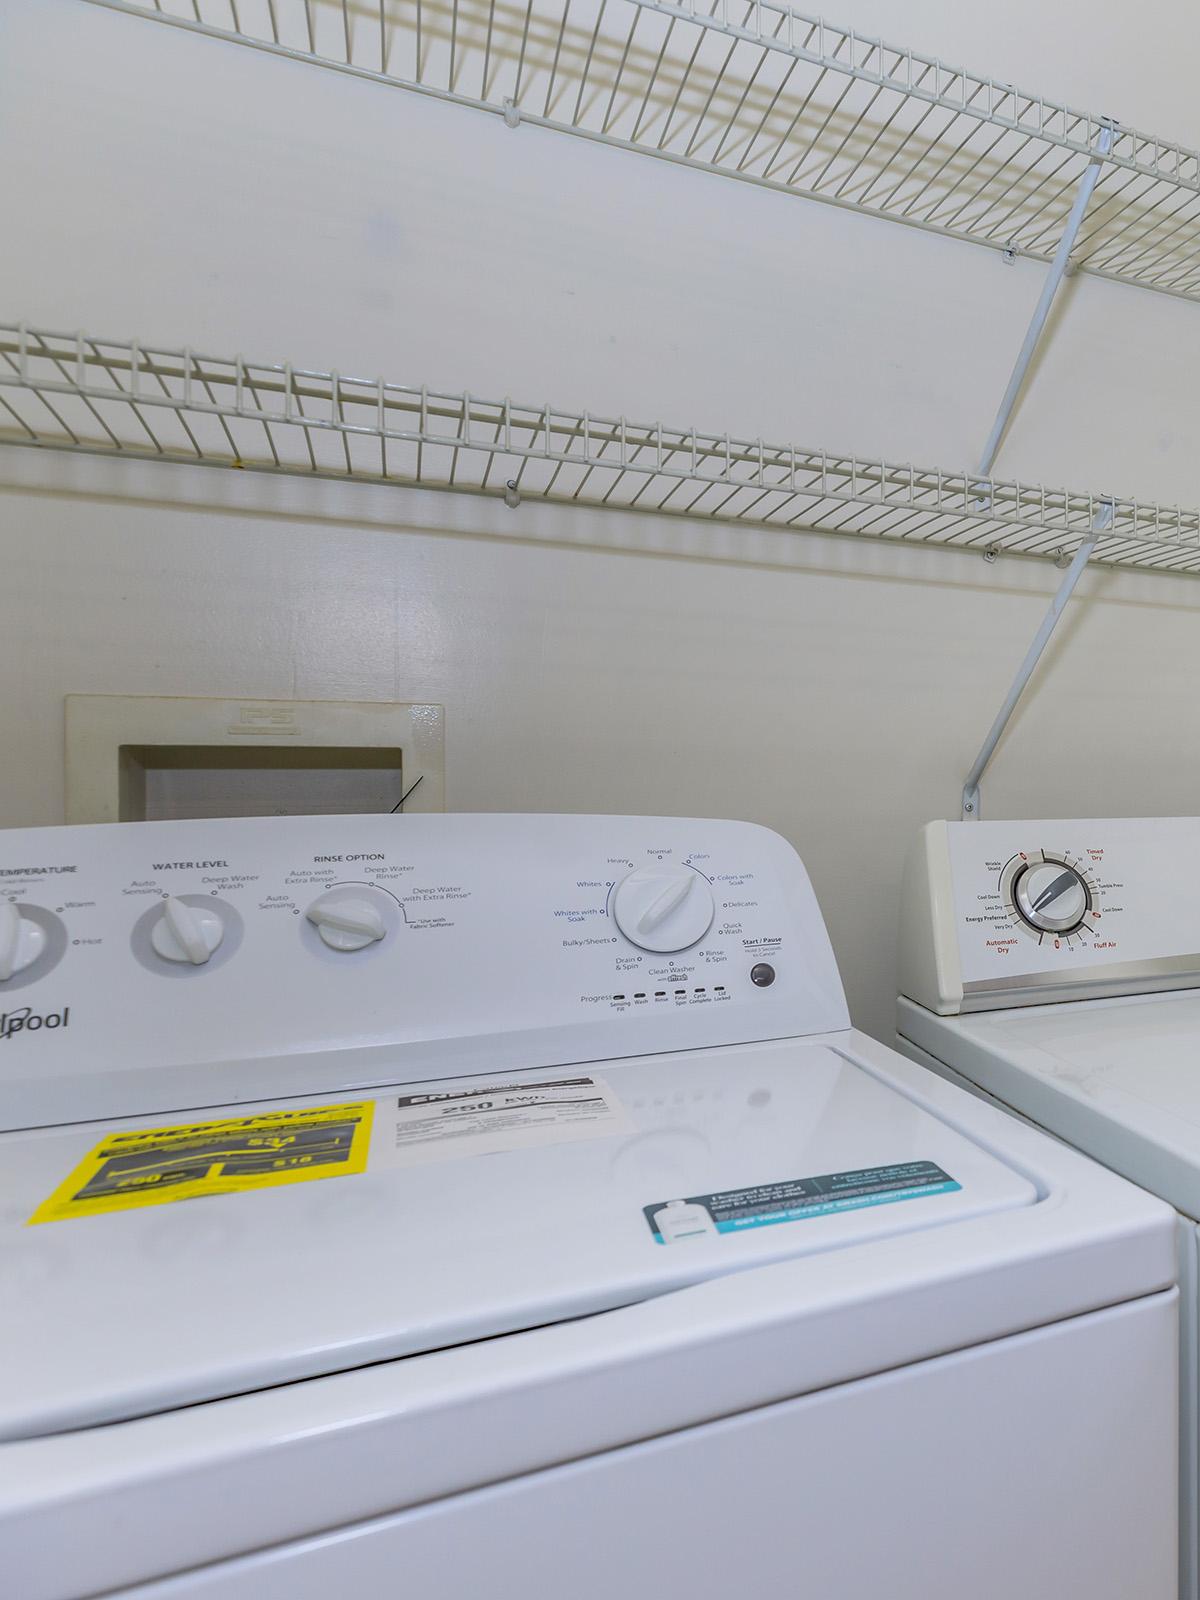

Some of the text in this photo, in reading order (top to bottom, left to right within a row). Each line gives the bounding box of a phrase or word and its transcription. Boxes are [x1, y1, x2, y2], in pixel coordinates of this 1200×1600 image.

[314, 854, 385, 863] RINSE OPTION
[152, 862, 193, 870] WATER
[562, 938, 610, 947] Bulky/Sheets
[580, 995, 612, 1003] Progress
